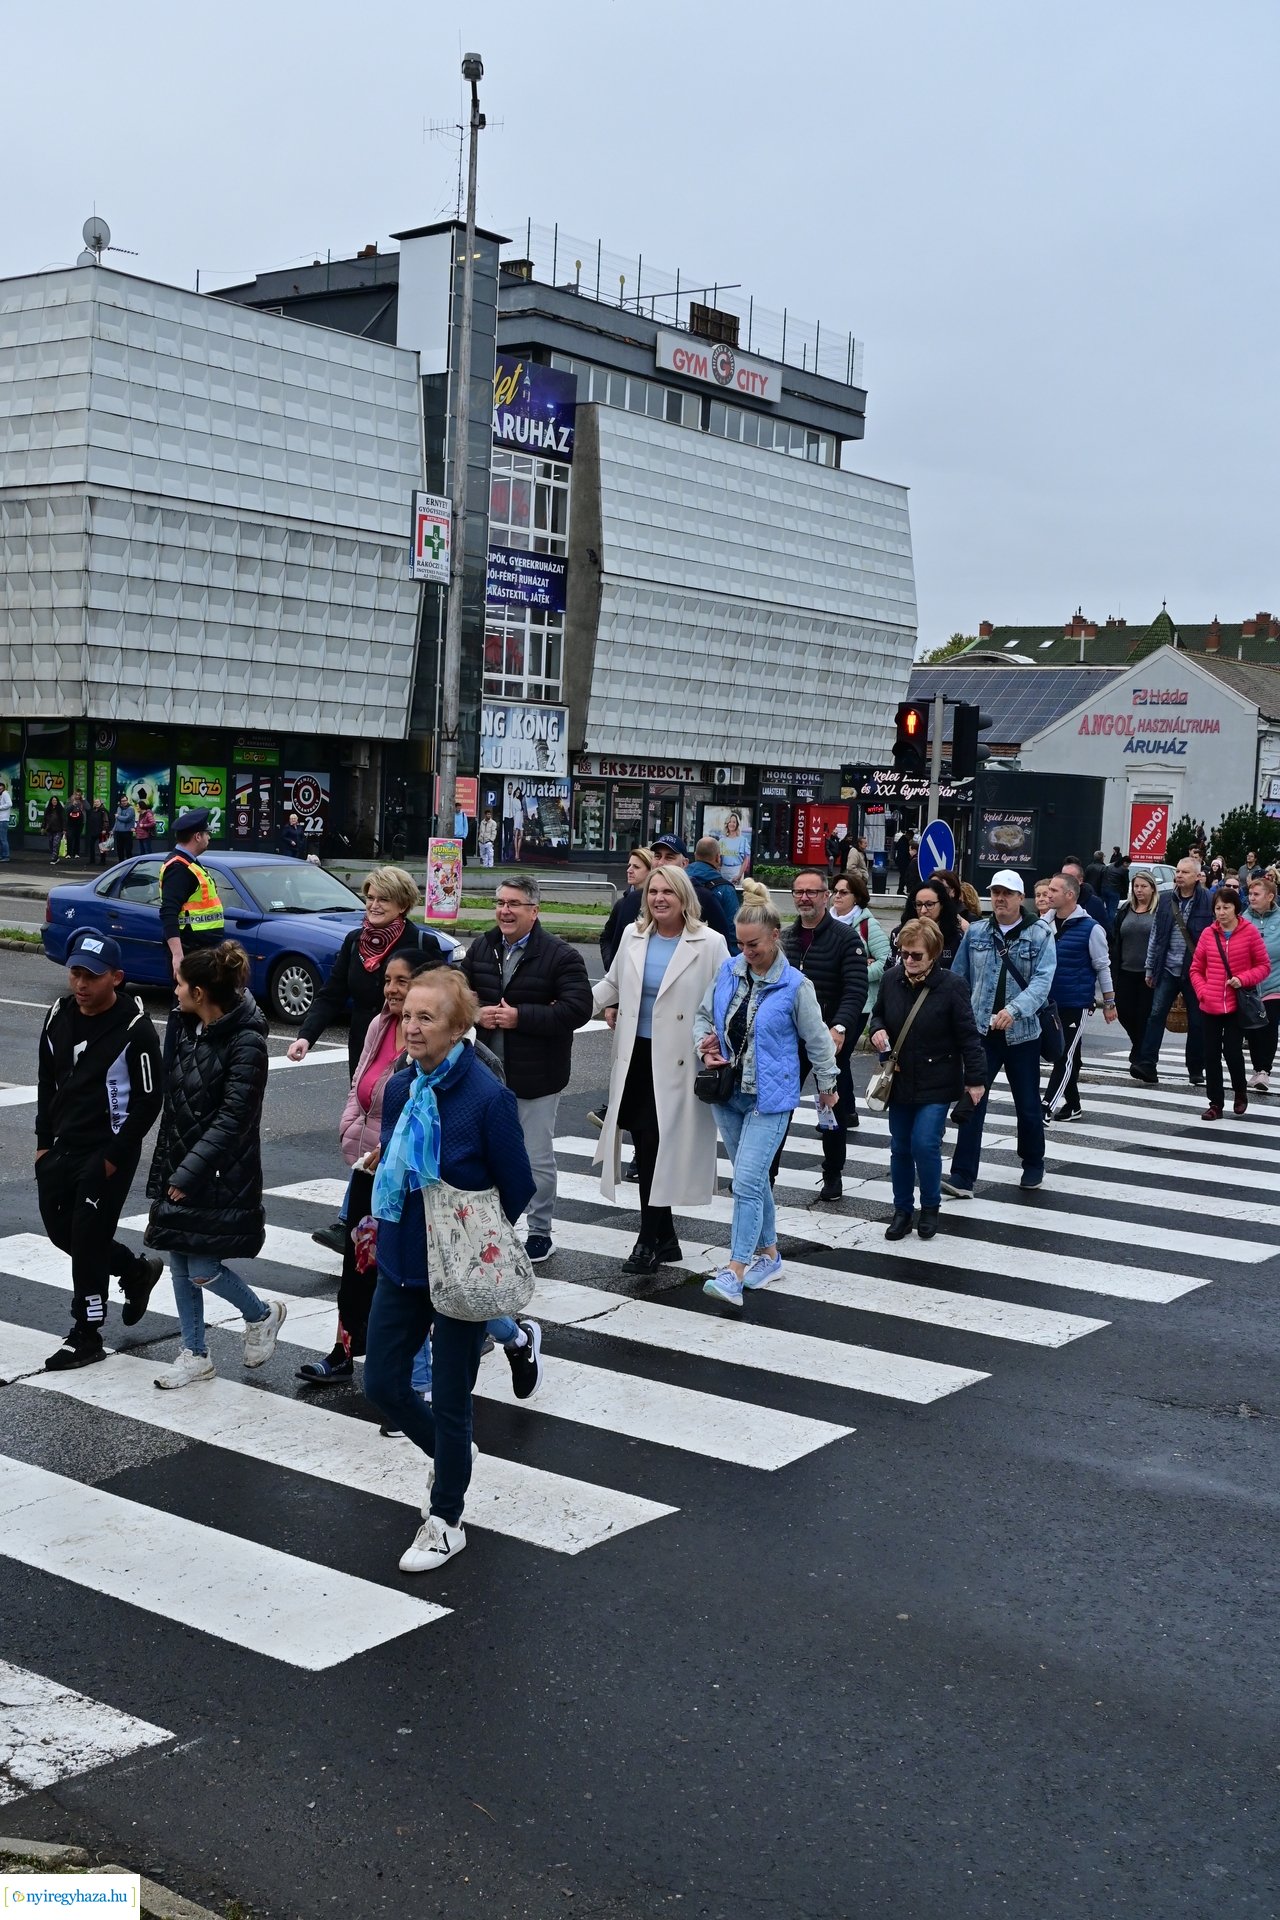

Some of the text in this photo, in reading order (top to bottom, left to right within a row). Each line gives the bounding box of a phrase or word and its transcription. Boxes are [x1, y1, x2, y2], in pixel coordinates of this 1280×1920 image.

[672, 347, 708, 378] GYM
[736, 368, 769, 396] CITY
[492, 403, 571, 453] ÁRUHÁZ
[509, 556, 565, 575] GYEREKRUHÁZAT
[518, 574, 550, 588] RUHÁZAT
[530, 592, 550, 605] JÁTÉK
[1149, 688, 1189, 705] Háda
[511, 712, 560, 742] KONG
[1077, 714, 1221, 736] ANGOL HASZNÁLTRUHA
[1123, 736, 1188, 755] ÁRUHÁZ
[599, 756, 695, 781] ÉKSZERBOLT.
[766, 770, 821, 781] HONG KONG
[873, 770, 900, 783] Kelet
[520, 778, 568, 798] Divatáru
[860, 782, 872, 794] és
[874, 783, 897, 796] XXL
[899, 783, 931, 801] Gyros
[487, 792, 495, 804] P
[983, 812, 1032, 826] Kelet Lángos
[1131, 807, 1166, 850] KIADÓ!
[796, 808, 806, 855] FOXPOST
[1146, 838, 1157, 850] 170
[986, 853, 1000, 861] XXL
[1001, 853, 1019, 864] Gyros
[191, 913, 215, 923] POLICE
[84, 1293, 104, 1322] PU
